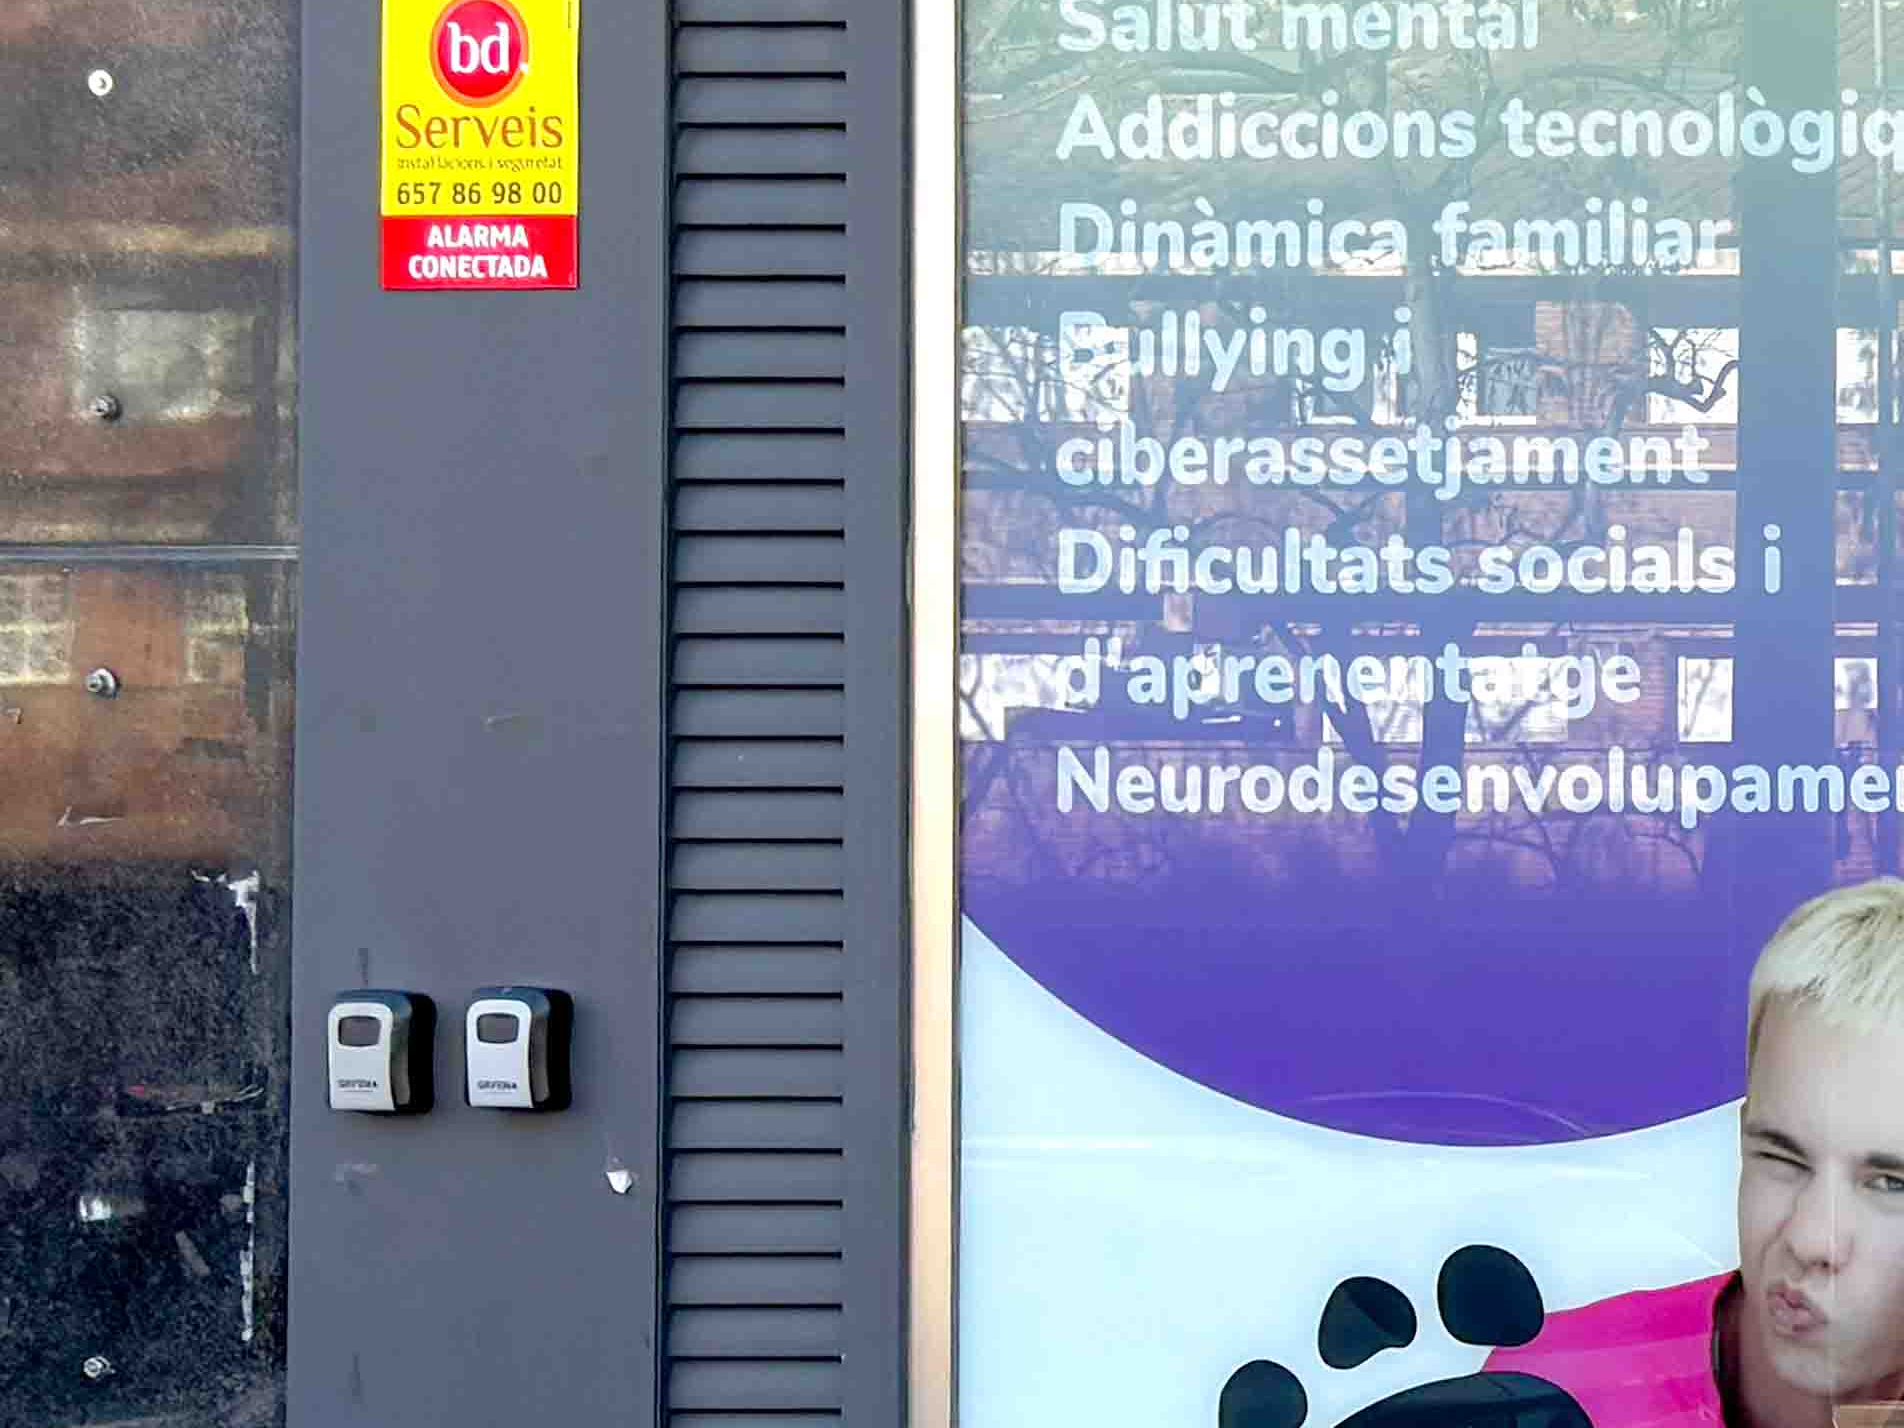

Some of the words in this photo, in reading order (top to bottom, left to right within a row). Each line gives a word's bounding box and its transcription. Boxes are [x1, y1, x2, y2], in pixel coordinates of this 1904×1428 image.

[396, 104, 564, 149] Serveis
[1055, 93, 1478, 162] Addiccions
[397, 181, 441, 205] 657
[451, 181, 481, 205] 86
[491, 181, 522, 205] 98
[532, 181, 562, 205] 00
[408, 254, 549, 280] CONECTADA
[427, 224, 529, 248] ALARMA
[1057, 198, 1409, 268] Dinàmica
[1433, 200, 1732, 269] familiar
[1057, 308, 1367, 390] Bullying
[1396, 306, 1411, 375] i
[1055, 420, 1710, 501] ciberassetjament
[1057, 527, 1452, 593] Dificultats
[1478, 528, 1736, 593] socials
[1765, 525, 1782, 593] i
[1056, 641, 1641, 718] d'aprenentatge
